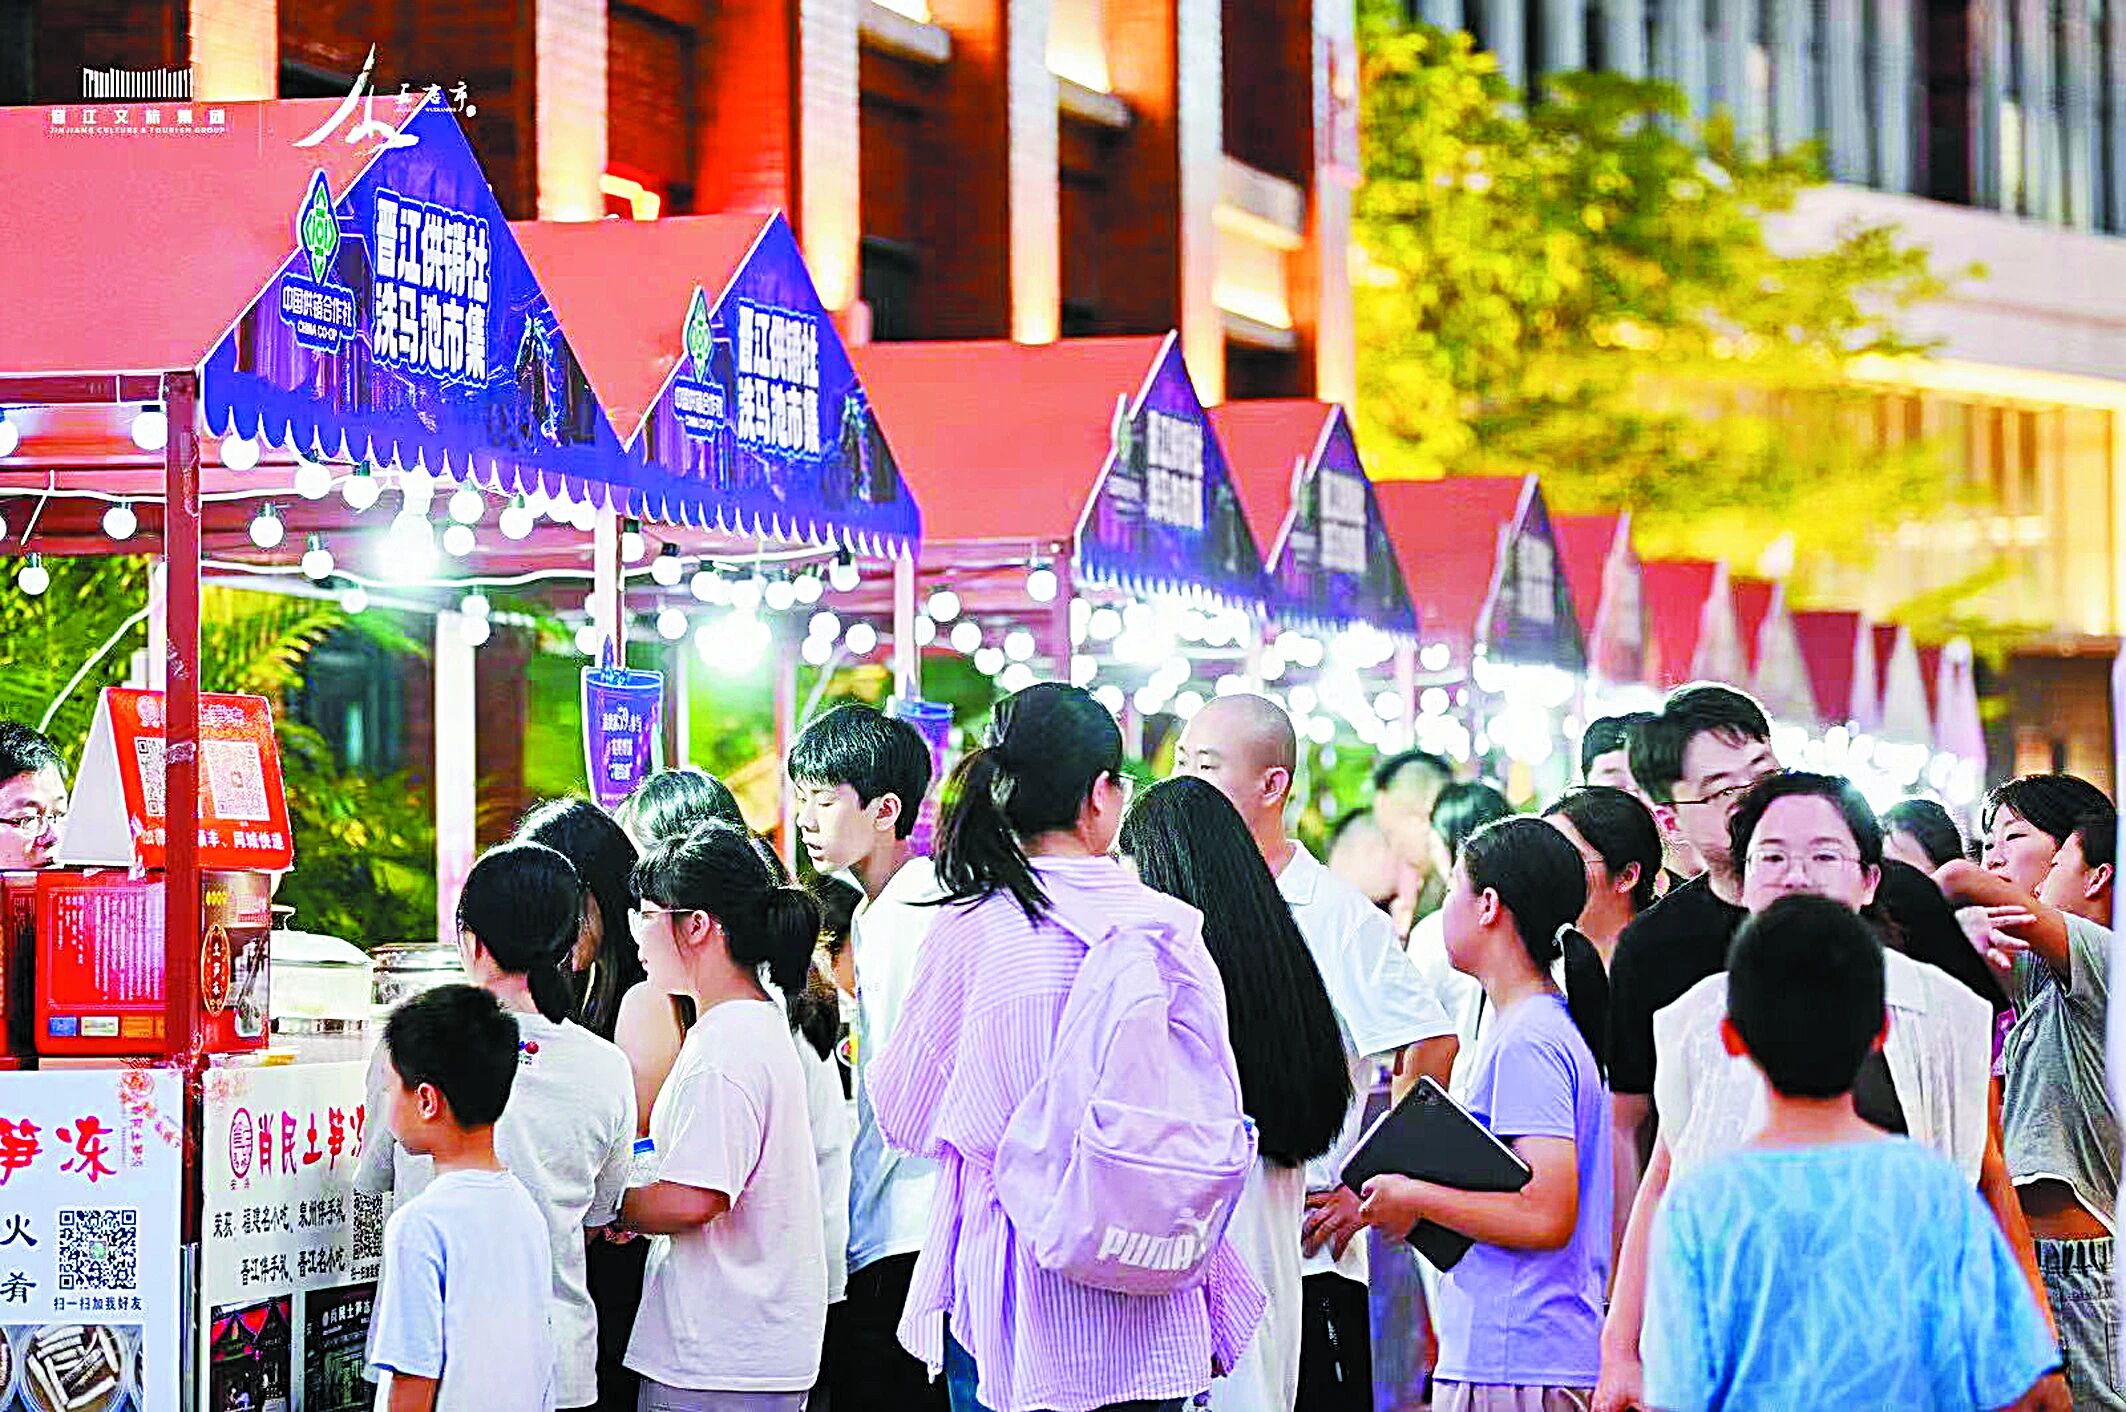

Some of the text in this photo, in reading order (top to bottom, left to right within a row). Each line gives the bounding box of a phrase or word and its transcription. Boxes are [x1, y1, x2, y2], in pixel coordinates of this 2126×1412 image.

[377, 198, 488, 303] 晋江供销社
[282, 285, 352, 328] 中国供销合作社
[374, 281, 486, 380] 洗马池市集
[0, 1214, 38, 1246] 火
[1096, 1225, 1195, 1271] PUMA
[0, 1272, 37, 1303] 肴
[54, 1295, 142, 1311] 扫一扫加我好友
